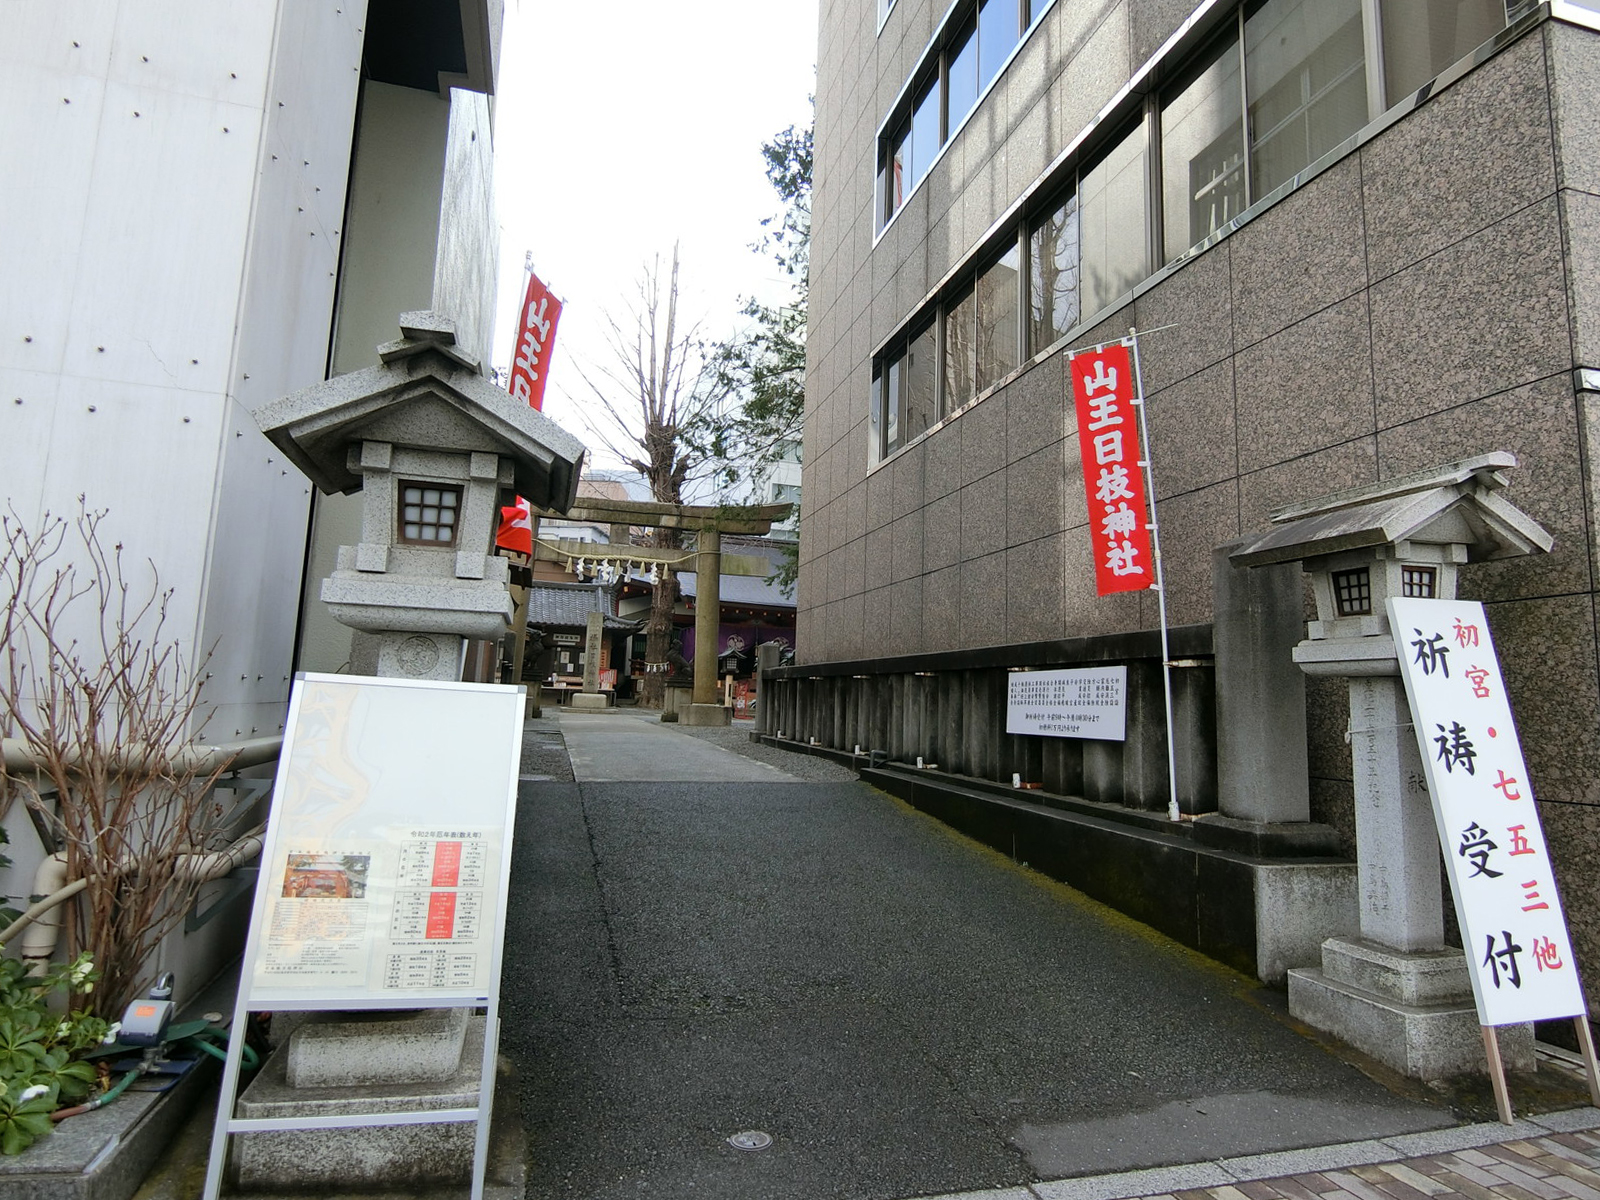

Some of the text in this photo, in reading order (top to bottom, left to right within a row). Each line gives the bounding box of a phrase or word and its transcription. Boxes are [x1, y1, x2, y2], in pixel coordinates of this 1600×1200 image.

[1083, 360, 1144, 577] 山王日枝神社
[1410, 628, 1523, 990] 祈祷受付
